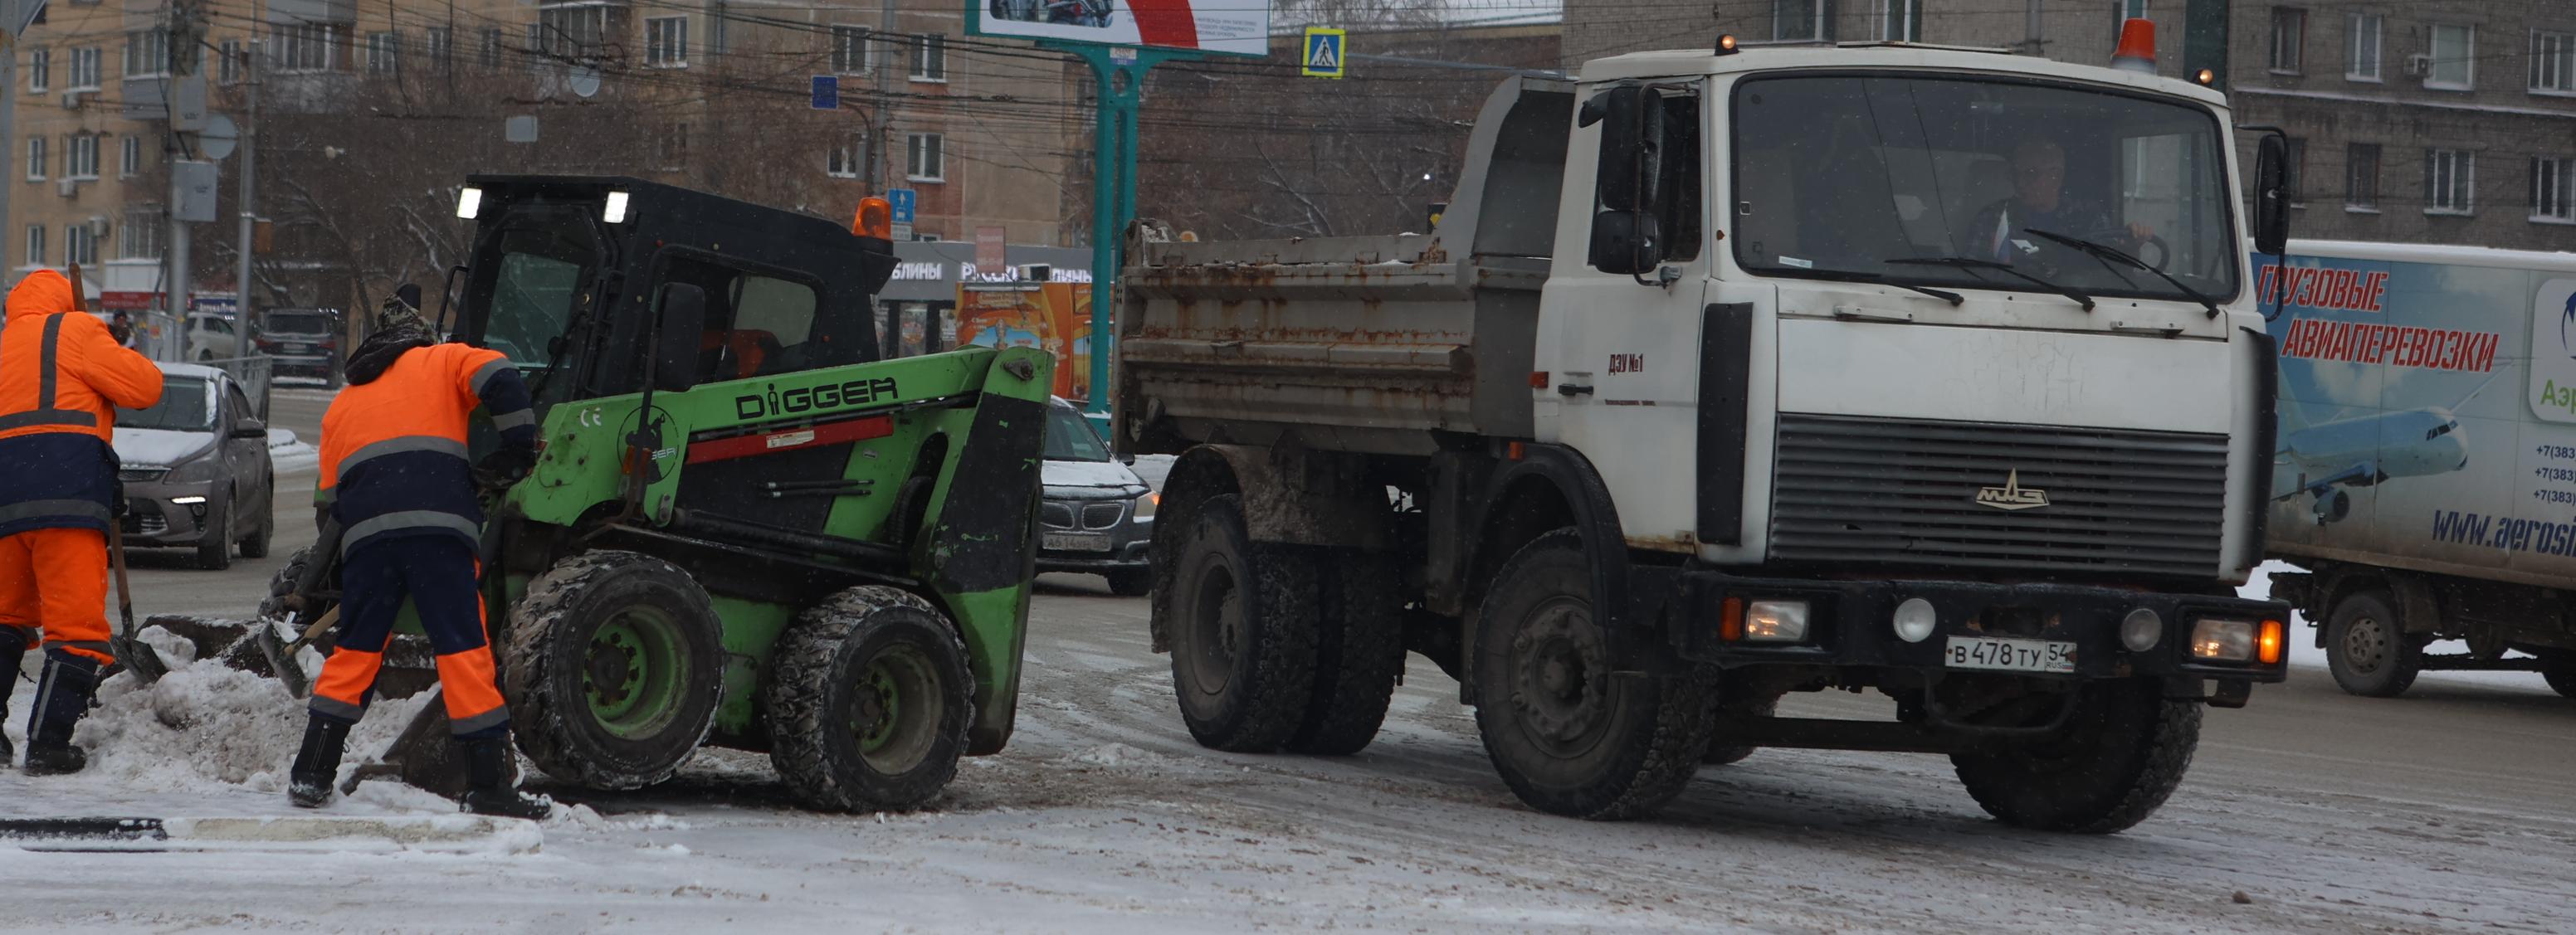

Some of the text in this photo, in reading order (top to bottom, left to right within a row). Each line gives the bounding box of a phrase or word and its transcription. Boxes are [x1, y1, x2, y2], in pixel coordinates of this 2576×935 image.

[891, 262, 943, 280] БЛИНЫ
[2256, 264, 2389, 312] ГРУЗОВЫЕ
[2281, 318, 2500, 373] АВИАПЕРЕВОЗКИ
[2536, 445, 2576, 460] +7(383
[2432, 509, 2576, 558] www.aerosi
[2048, 644, 2068, 662] 54
